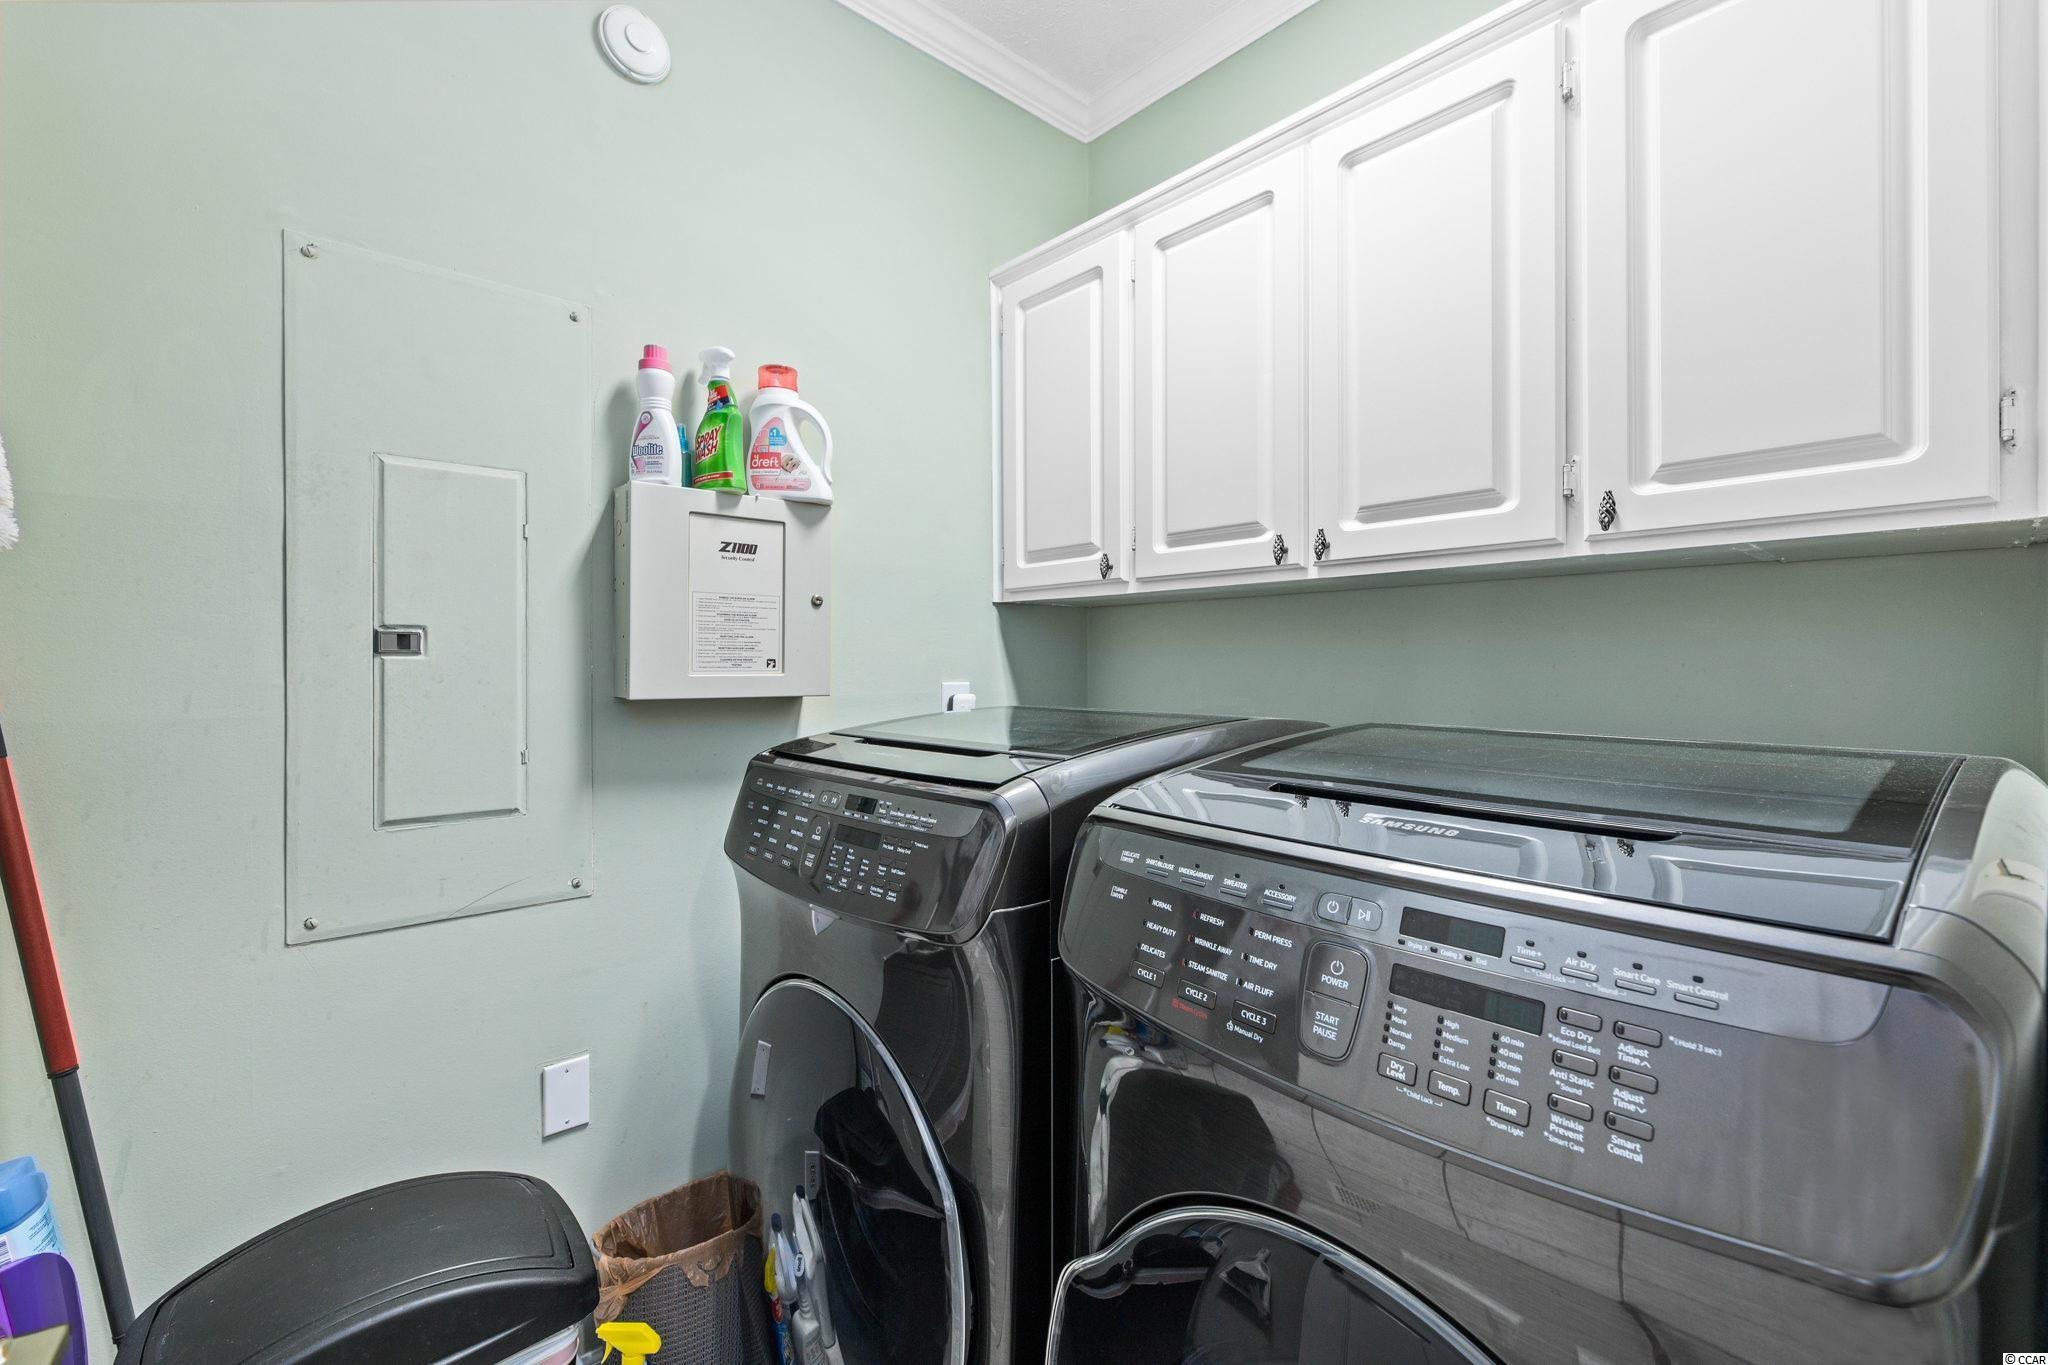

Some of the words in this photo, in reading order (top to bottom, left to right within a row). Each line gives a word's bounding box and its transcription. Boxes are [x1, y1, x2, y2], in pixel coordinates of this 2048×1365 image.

[632, 443, 663, 456] Woolite
[752, 454, 778, 467] dreft
[1358, 815, 1460, 836] SAMSUNG
[1178, 866, 1214, 881] UNDERGARMENT
[1223, 878, 1248, 890] SWEATER
[1264, 889, 1296, 902] ACCESSORY
[1152, 899, 1172, 912] NORMAL
[1200, 913, 1224, 927] REFRESH
[1146, 921, 1162, 932] HEAVY
[1162, 926, 1176, 937] DUTY
[1194, 936, 1217, 950] WRINKLE
[1217, 944, 1233, 956] AWAY
[1254, 929, 1272, 942] PERM
[1272, 935, 1292, 948] PRESS
[1140, 943, 1166, 959] DELICATES
[1516, 946, 1542, 958] Time+
[1249, 954, 1264, 966] TIME
[1264, 959, 1278, 971] DRY
[1565, 957, 1579, 967] Air
[1580, 960, 1597, 972] Dry
[1137, 968, 1153, 980] CYCLE
[1188, 960, 1206, 974] STEAM
[1206, 966, 1229, 981] SANITIZE
[1613, 967, 1639, 981] Smart
[1640, 973, 1661, 986] Care
[1243, 980, 1254, 991] AIR
[1254, 984, 1275, 997] FLUFF
[1321, 974, 1349, 989] POWER
[1185, 987, 1203, 1001] CYCLE
[1203, 993, 1208, 1002] 2
[1666, 979, 1694, 994] Smart
[1694, 985, 1729, 1001] Control
[1393, 1003, 1407, 1014] Very
[1241, 1009, 1261, 1024] CYCLE
[1261, 1017, 1267, 1026] 3
[1315, 1011, 1340, 1025] START
[1391, 1015, 1407, 1026] More
[1444, 1019, 1460, 1030] High
[1234, 1025, 1253, 1039] Manual
[1253, 1032, 1264, 1044] Dry
[1313, 1025, 1337, 1040] PAUSE
[1390, 1027, 1412, 1040] Normal
[1442, 1032, 1469, 1045] Medium
[1560, 1026, 1576, 1038] Eco
[1577, 1031, 1594, 1043] Dry
[1388, 1038, 1406, 1050] Damp
[1441, 1043, 1455, 1053] Low
[1500, 1036, 1511, 1045] 60
[1511, 1039, 1525, 1048] min
[1499, 1048, 1509, 1057] 40
[1509, 1051, 1523, 1061] min
[1618, 1043, 1650, 1058] Adjust
[1390, 1060, 1404, 1073] Dry
[1439, 1056, 1456, 1068] Extra
[1456, 1061, 1471, 1071] Low
[1617, 1052, 1640, 1066] Time
[1386, 1068, 1406, 1081] Level
[1497, 1060, 1508, 1069] 30
[1508, 1064, 1521, 1074] min
[1496, 1073, 1506, 1082] 20
[1506, 1076, 1519, 1086] min
[1549, 1068, 1568, 1081] Anti
[1568, 1073, 1595, 1089] Static
[1437, 1080, 1461, 1096] Temp.
[1421, 1095, 1434, 1106] Lock
[1613, 1088, 1645, 1104] Adjust
[1496, 1101, 1517, 1116] Time
[1612, 1097, 1635, 1112] Time
[1551, 1113, 1585, 1132] Wrinkle
[1508, 1124, 1525, 1137] Light
[1550, 1123, 1584, 1142] Prevent
[1611, 1134, 1642, 1152] Smart
[1607, 1144, 1643, 1164] Control
